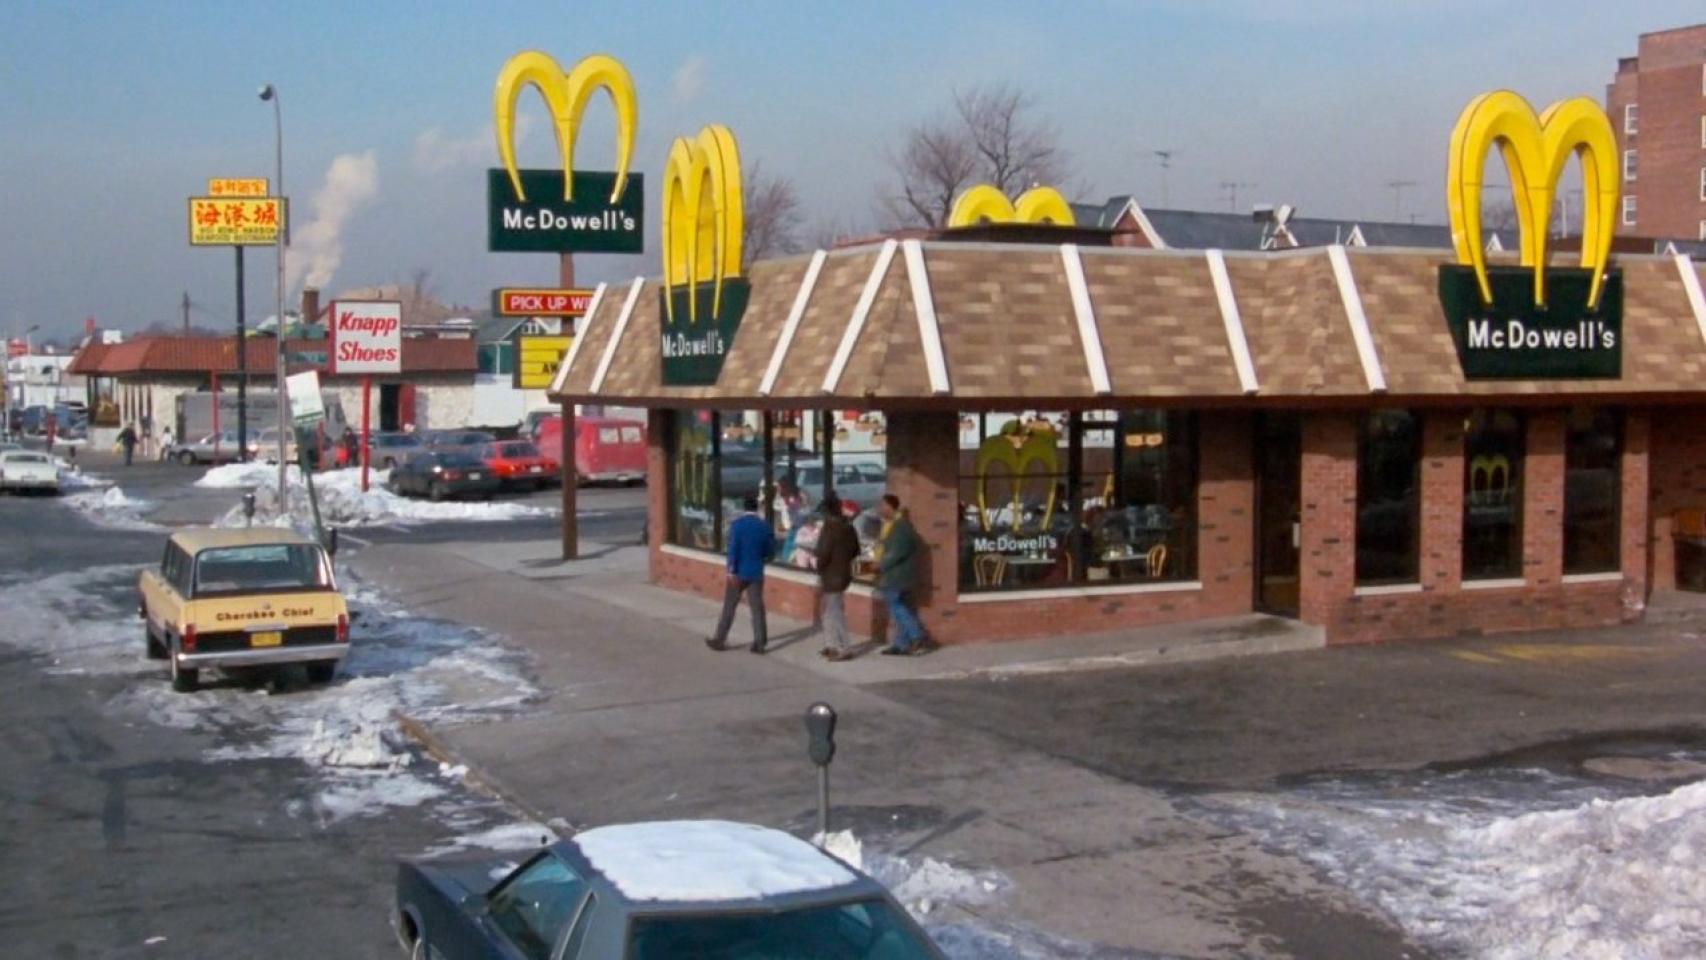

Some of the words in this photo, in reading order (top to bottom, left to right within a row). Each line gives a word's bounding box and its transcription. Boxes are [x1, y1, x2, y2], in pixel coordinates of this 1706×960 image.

[503, 208, 635, 231] McDowell's
[511, 295, 543, 310] PICK
[547, 296, 566, 310] UP
[338, 311, 398, 336] Knapp
[1468, 319, 1615, 349] McDowell's
[338, 341, 398, 361] Shoes
[662, 328, 724, 358] McDowell's
[974, 535, 1057, 552] McDowell's
[215, 610, 276, 621] Cherokee
[281, 607, 314, 617] Chief
